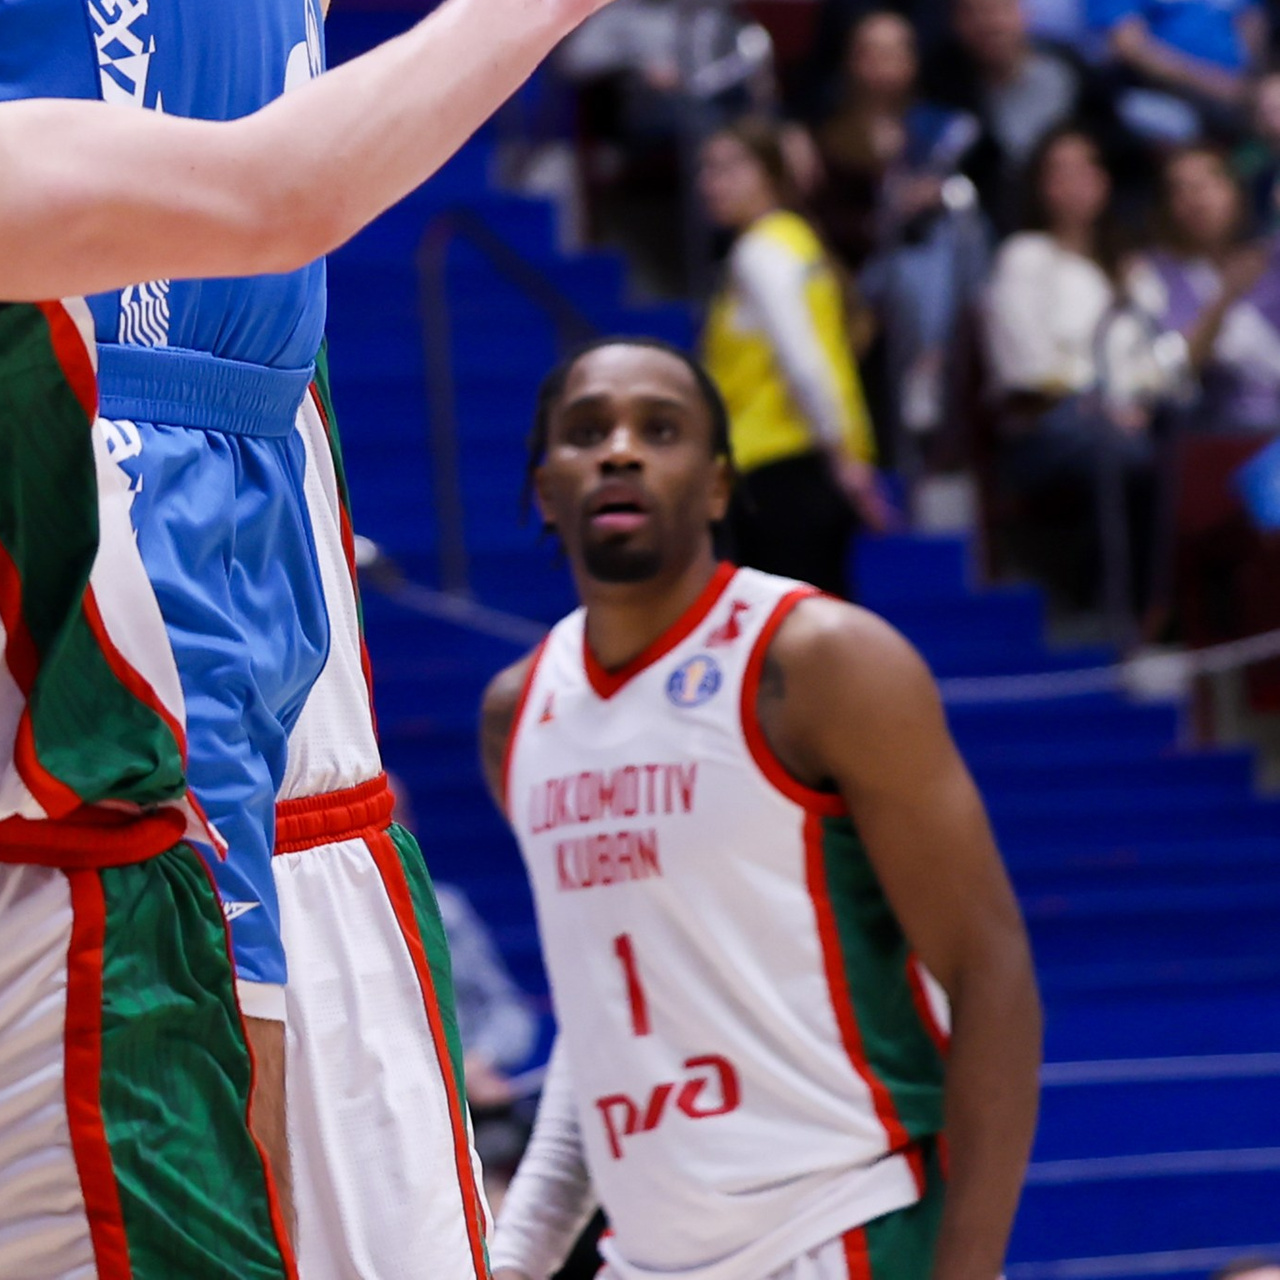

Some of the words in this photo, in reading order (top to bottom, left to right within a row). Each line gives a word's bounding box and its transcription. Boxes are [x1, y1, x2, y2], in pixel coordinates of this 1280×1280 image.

[528, 760, 698, 836] LOKOMOTIV
[555, 827, 664, 894] KUBAN
[613, 931, 653, 1037] 1
